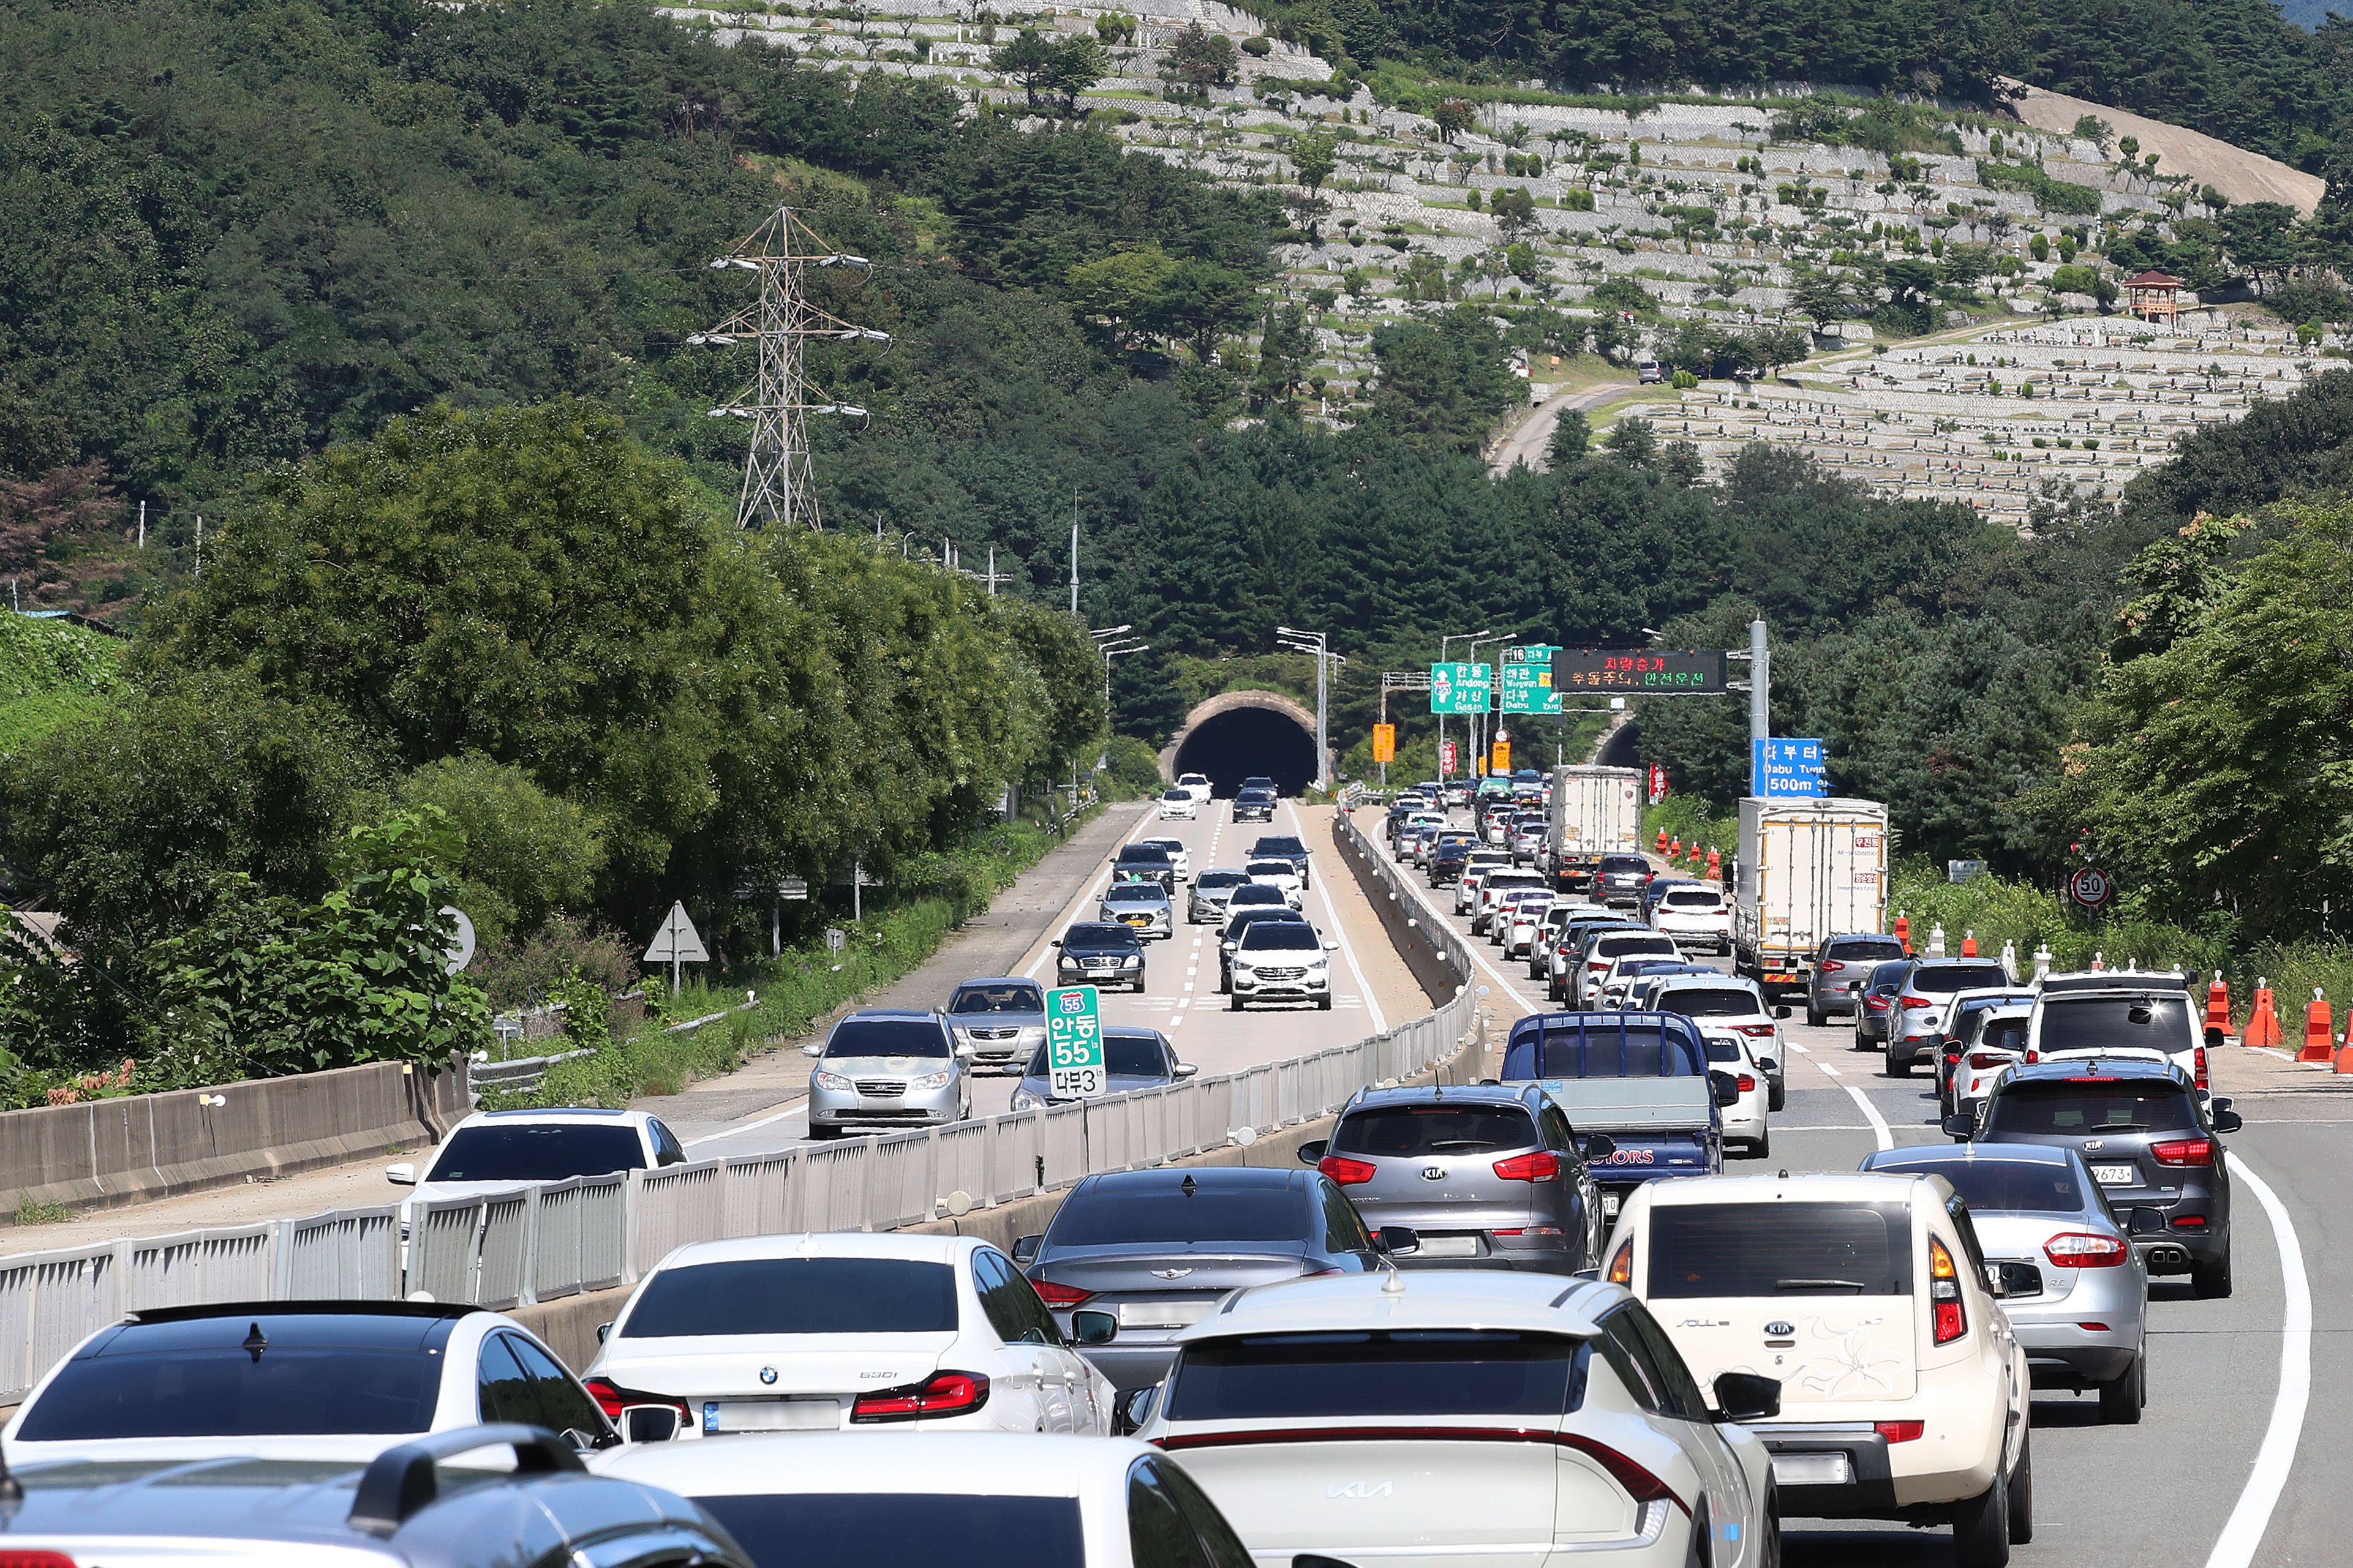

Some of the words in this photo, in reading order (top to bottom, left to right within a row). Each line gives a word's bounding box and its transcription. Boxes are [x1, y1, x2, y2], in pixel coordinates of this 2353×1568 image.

[1513, 649, 1524, 661] 16
[1456, 666, 1482, 678] 안동
[1506, 667, 1530, 680] 왜관
[1456, 678, 1489, 689] Andong
[1644, 672, 1704, 686] 안전운전
[1456, 689, 1483, 702] 가산
[1506, 688, 1529, 702] 다부
[1763, 745, 1829, 760] 다부터
[1799, 764, 1826, 773] Tunn
[1770, 778, 1812, 791] 500m
[2080, 878, 2100, 893] 50
[1064, 999, 1080, 1012] 55
[1051, 1015, 1096, 1041] 안동
[1056, 1040, 1091, 1065] 55
[1424, 1169, 1444, 1178] KIA
[1769, 1325, 1790, 1334] KIA
